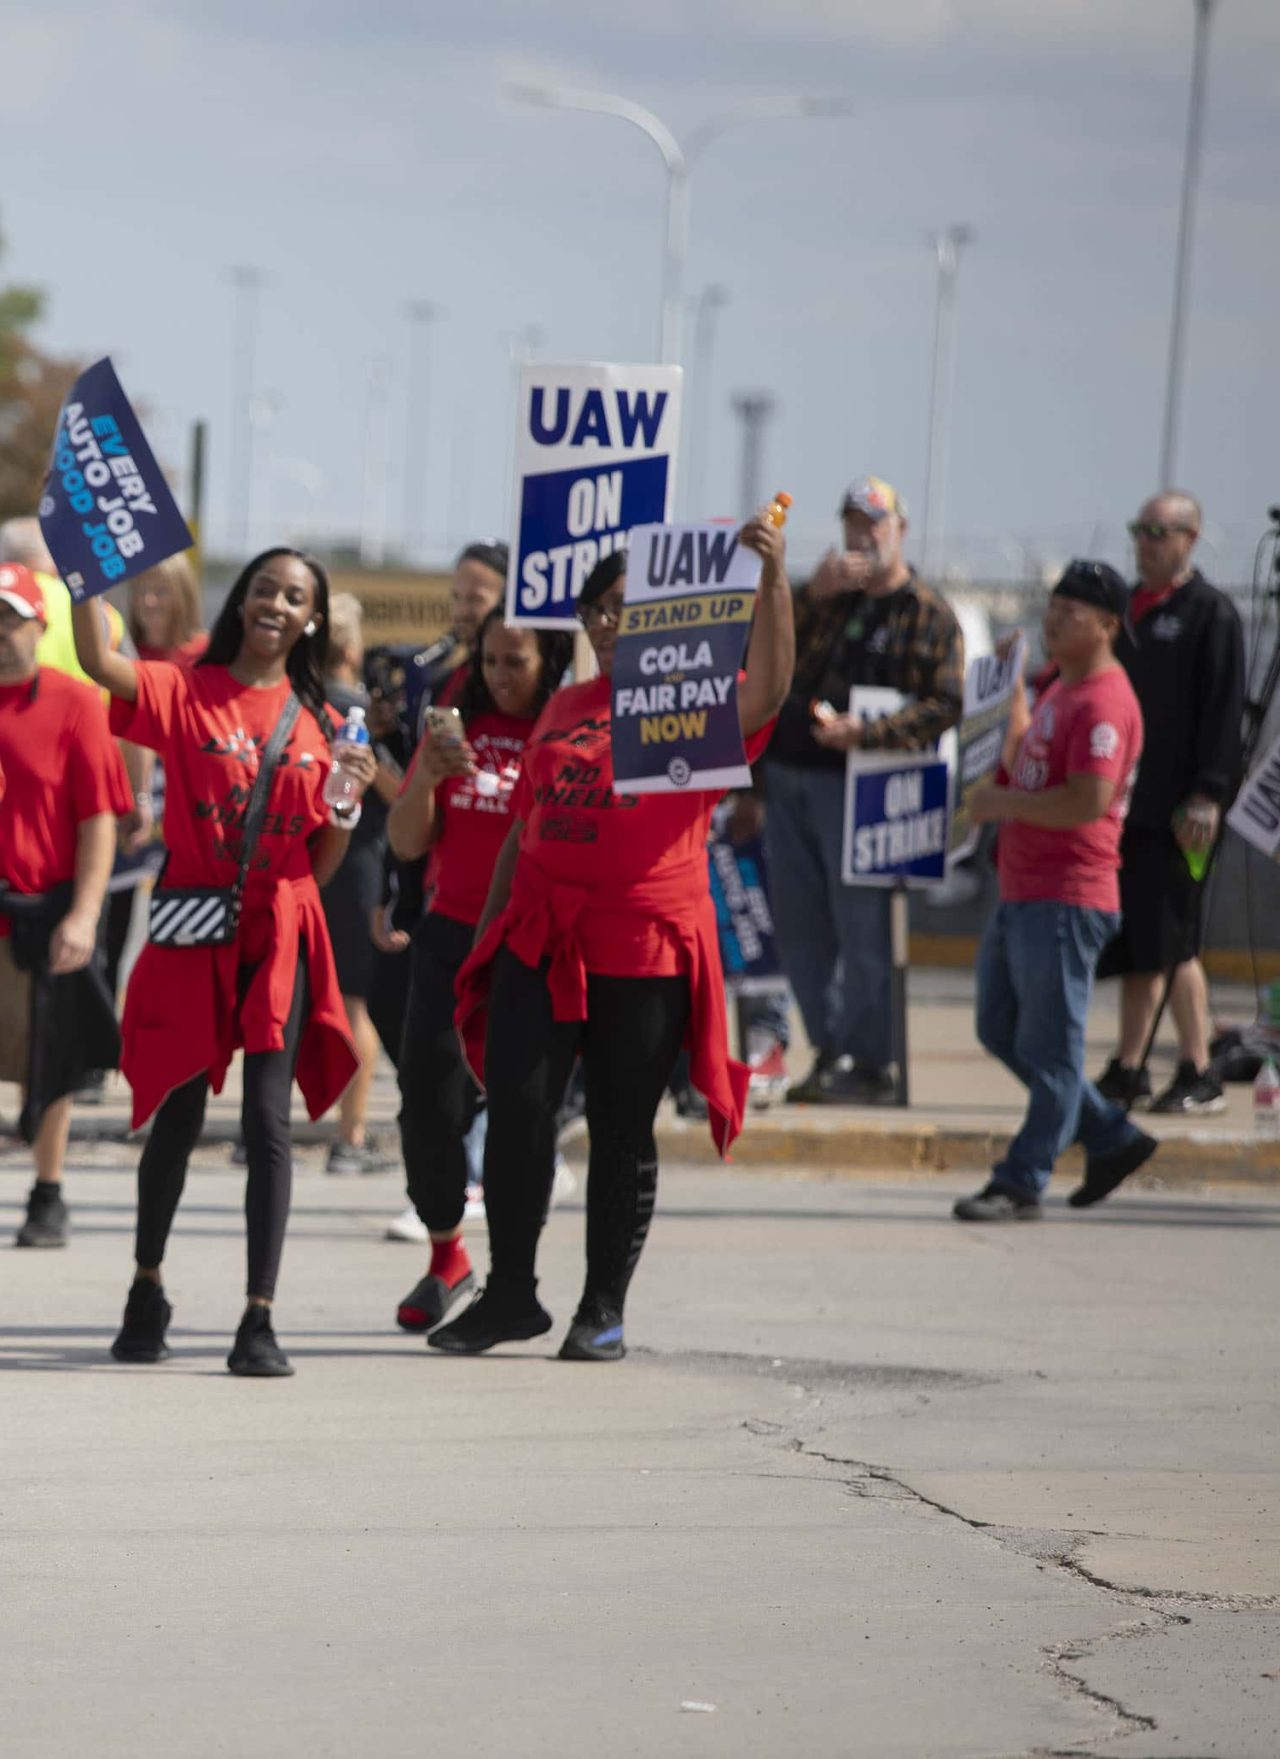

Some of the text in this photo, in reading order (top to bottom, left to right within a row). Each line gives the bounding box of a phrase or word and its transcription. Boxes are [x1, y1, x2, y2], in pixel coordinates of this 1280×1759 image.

[528, 386, 668, 448] UAW
[66, 402, 145, 558] AUTO JOB
[89, 414, 158, 515] EVERY
[566, 471, 623, 538] ON
[82, 521, 126, 580] JOB
[520, 530, 632, 611] STR
[647, 531, 739, 588] UAW
[627, 598, 744, 630] STAND UP
[639, 641, 713, 675] COLA
[616, 676, 734, 717] FAIR PAY
[639, 710, 708, 746] NOW
[885, 772, 924, 821] ON
[855, 806, 946, 873] STRIKE
